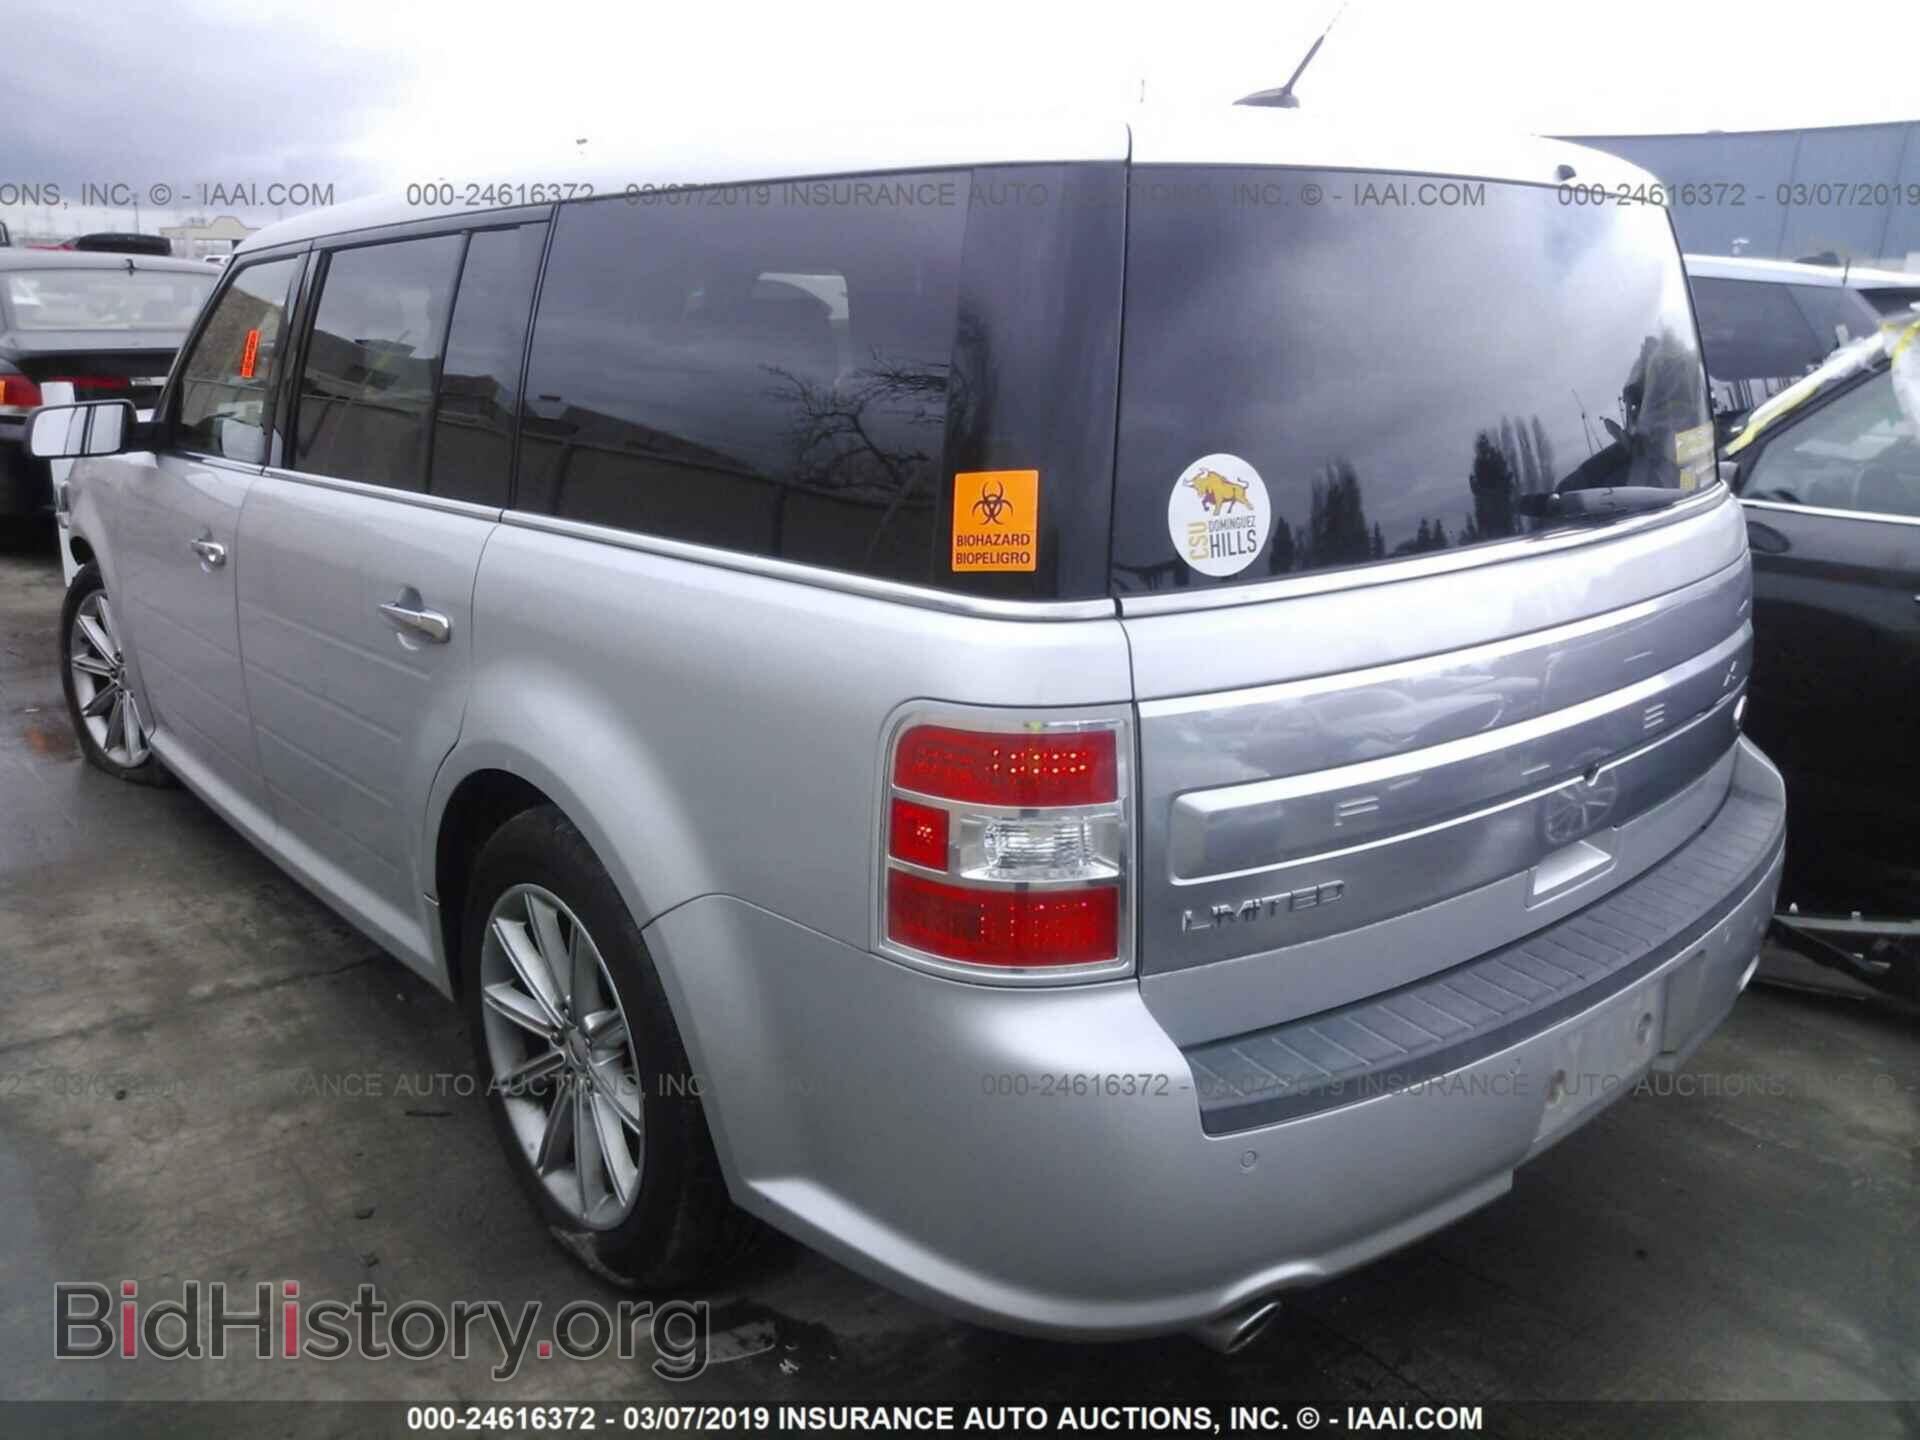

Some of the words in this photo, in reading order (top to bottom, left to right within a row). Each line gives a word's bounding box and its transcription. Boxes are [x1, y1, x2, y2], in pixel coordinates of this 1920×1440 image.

[956, 533, 1031, 547] BIOHAZARD
[1187, 520, 1209, 560] CSU
[1208, 528, 1257, 559] HILLS
[955, 551, 1031, 565] BIOPELIGRO
[1181, 879, 1345, 934] LIMITED
